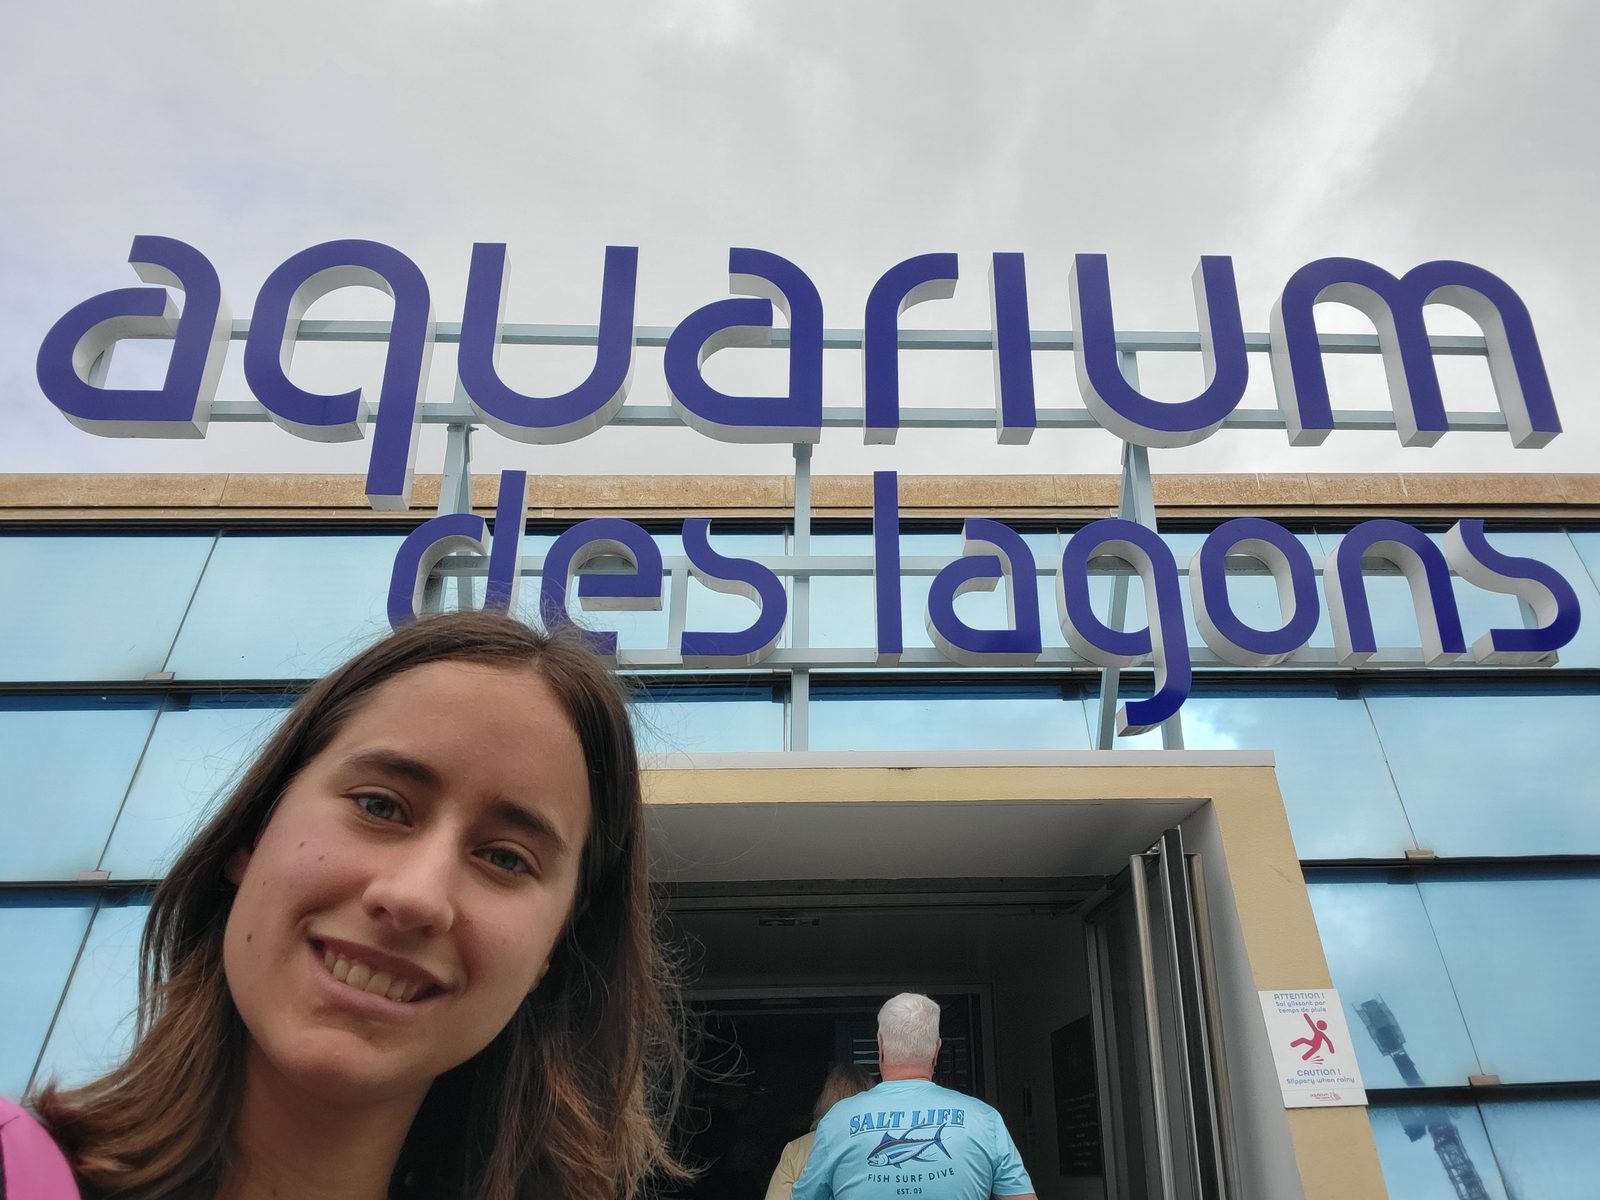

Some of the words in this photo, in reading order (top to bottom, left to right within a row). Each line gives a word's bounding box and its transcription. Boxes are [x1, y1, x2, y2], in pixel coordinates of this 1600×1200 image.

[37, 235, 1562, 506] aquarium
[388, 470, 788, 660] des
[873, 470, 1582, 729] lagons
[1274, 992, 1320, 1000] ATTENTION
[850, 1111, 905, 1136] SALT
[910, 1109, 965, 1127] LIFE
[867, 1173, 890, 1183] FISH
[895, 1173, 923, 1183] SURF
[928, 1167, 955, 1181] DIVE
[913, 1187, 923, 1195] 03
